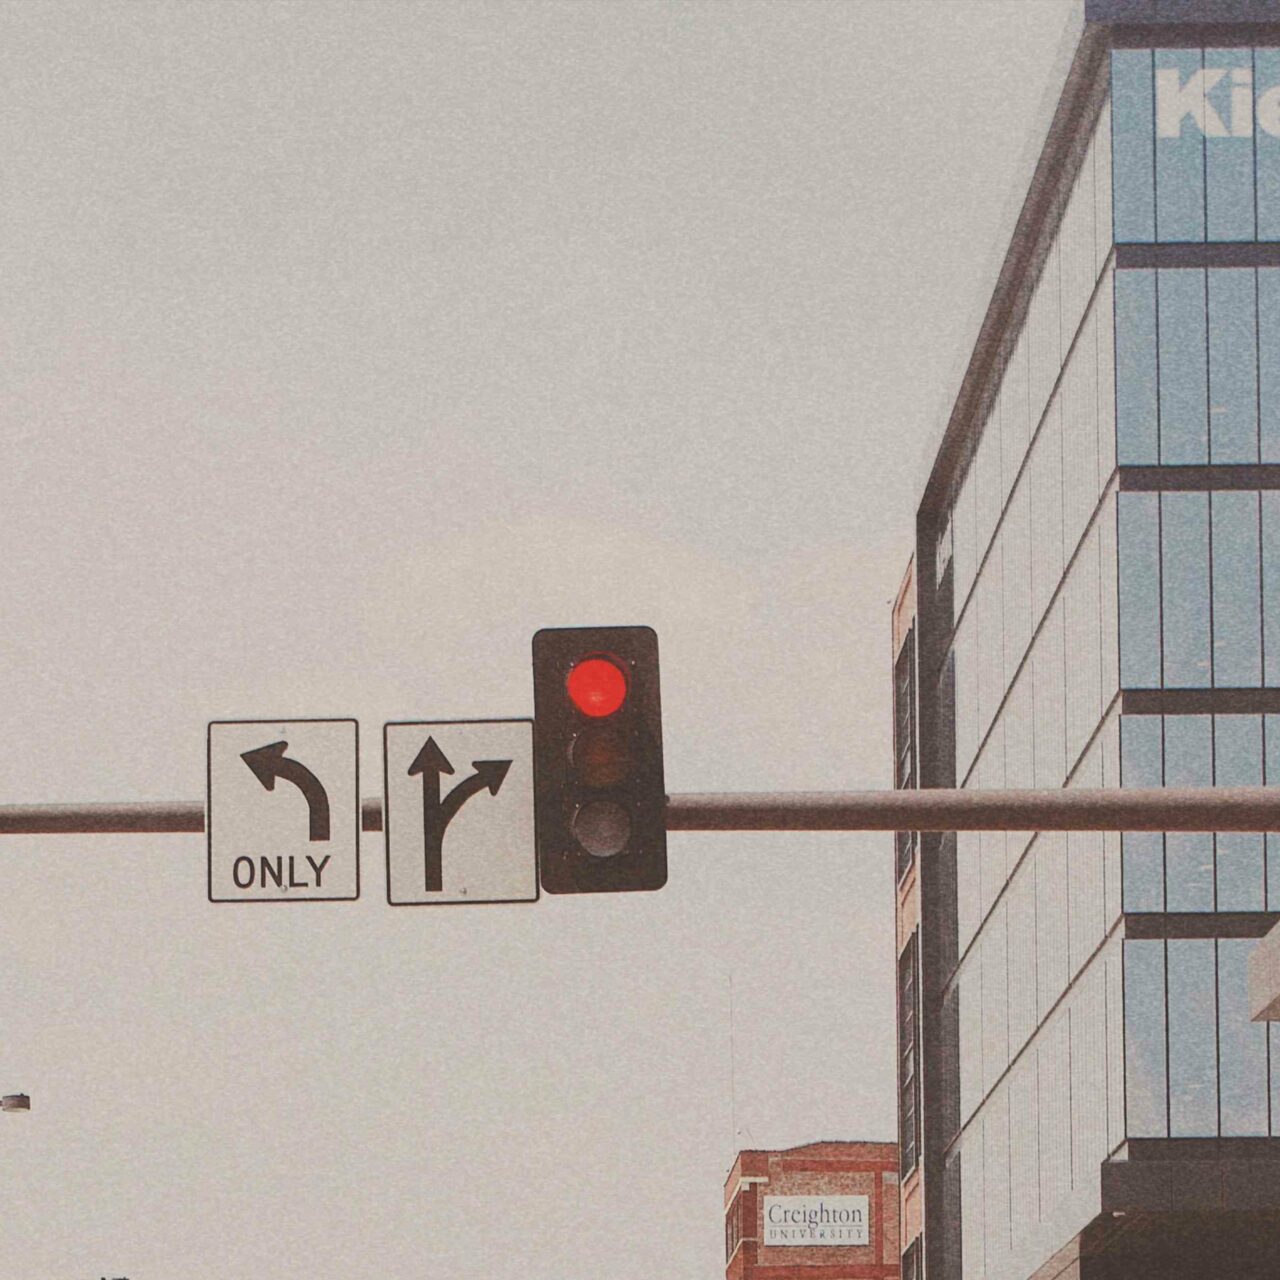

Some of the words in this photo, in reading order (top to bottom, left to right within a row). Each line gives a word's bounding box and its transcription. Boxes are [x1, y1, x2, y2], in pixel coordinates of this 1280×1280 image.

[232, 855, 331, 889] ONLY
[768, 1202, 862, 1229] Creighton
[769, 1229, 863, 1239] UNIVERSITY
